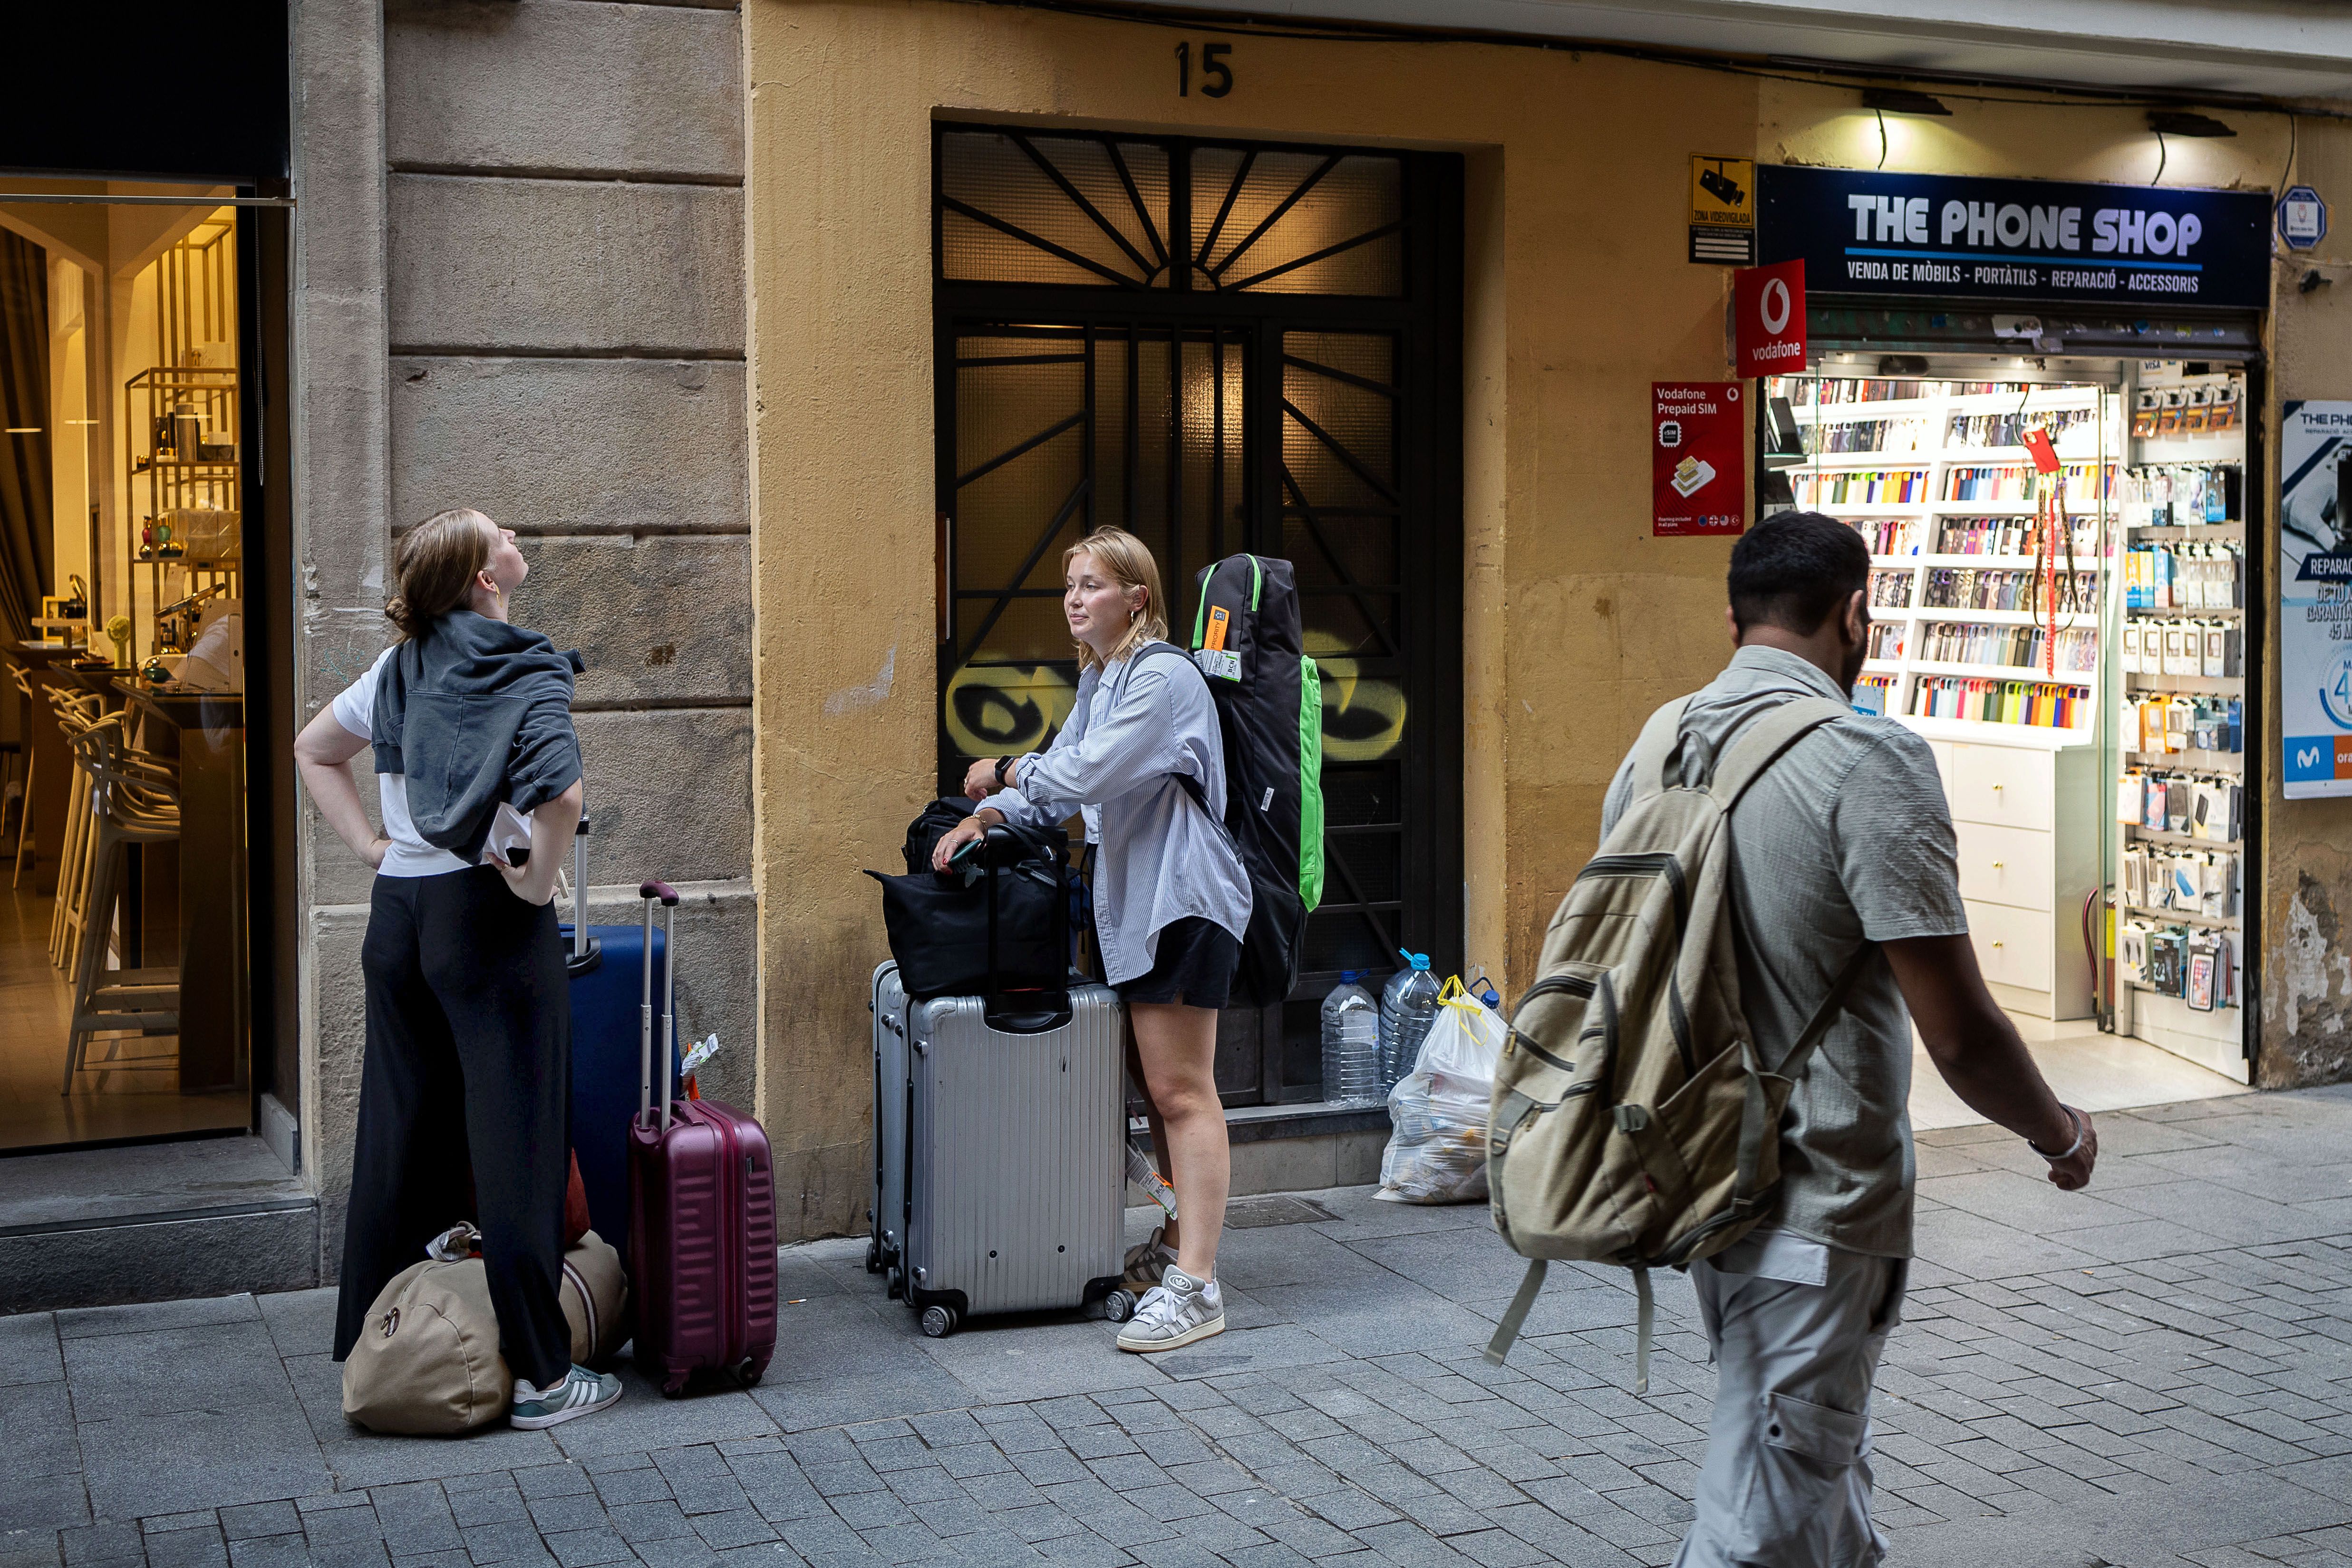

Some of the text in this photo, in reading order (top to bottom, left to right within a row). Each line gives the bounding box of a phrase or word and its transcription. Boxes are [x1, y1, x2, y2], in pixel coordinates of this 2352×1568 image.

[1174, 42, 1233, 98] 15
[1694, 209, 1751, 224] ZONA VIDEOVIGILADA
[1848, 194, 2202, 256] THE PHONE SHOP
[1848, 261, 1889, 280] VENDA
[1893, 263, 1909, 281] DE
[1912, 259, 1960, 283] MÒBILS
[1975, 264, 2037, 286] PORTÀTILS
[2052, 269, 2116, 289] REPARACIÓ
[2129, 274, 2199, 293] ACCESSORIS
[1752, 340, 1801, 361] vodafone
[1657, 388, 1706, 399] Vodafone
[1658, 403, 1717, 416] Prepaid SIM
[2301, 413, 2352, 426] THE PH
[2317, 585, 2331, 603] DE
[1211, 621, 1220, 649] PRIORITY
